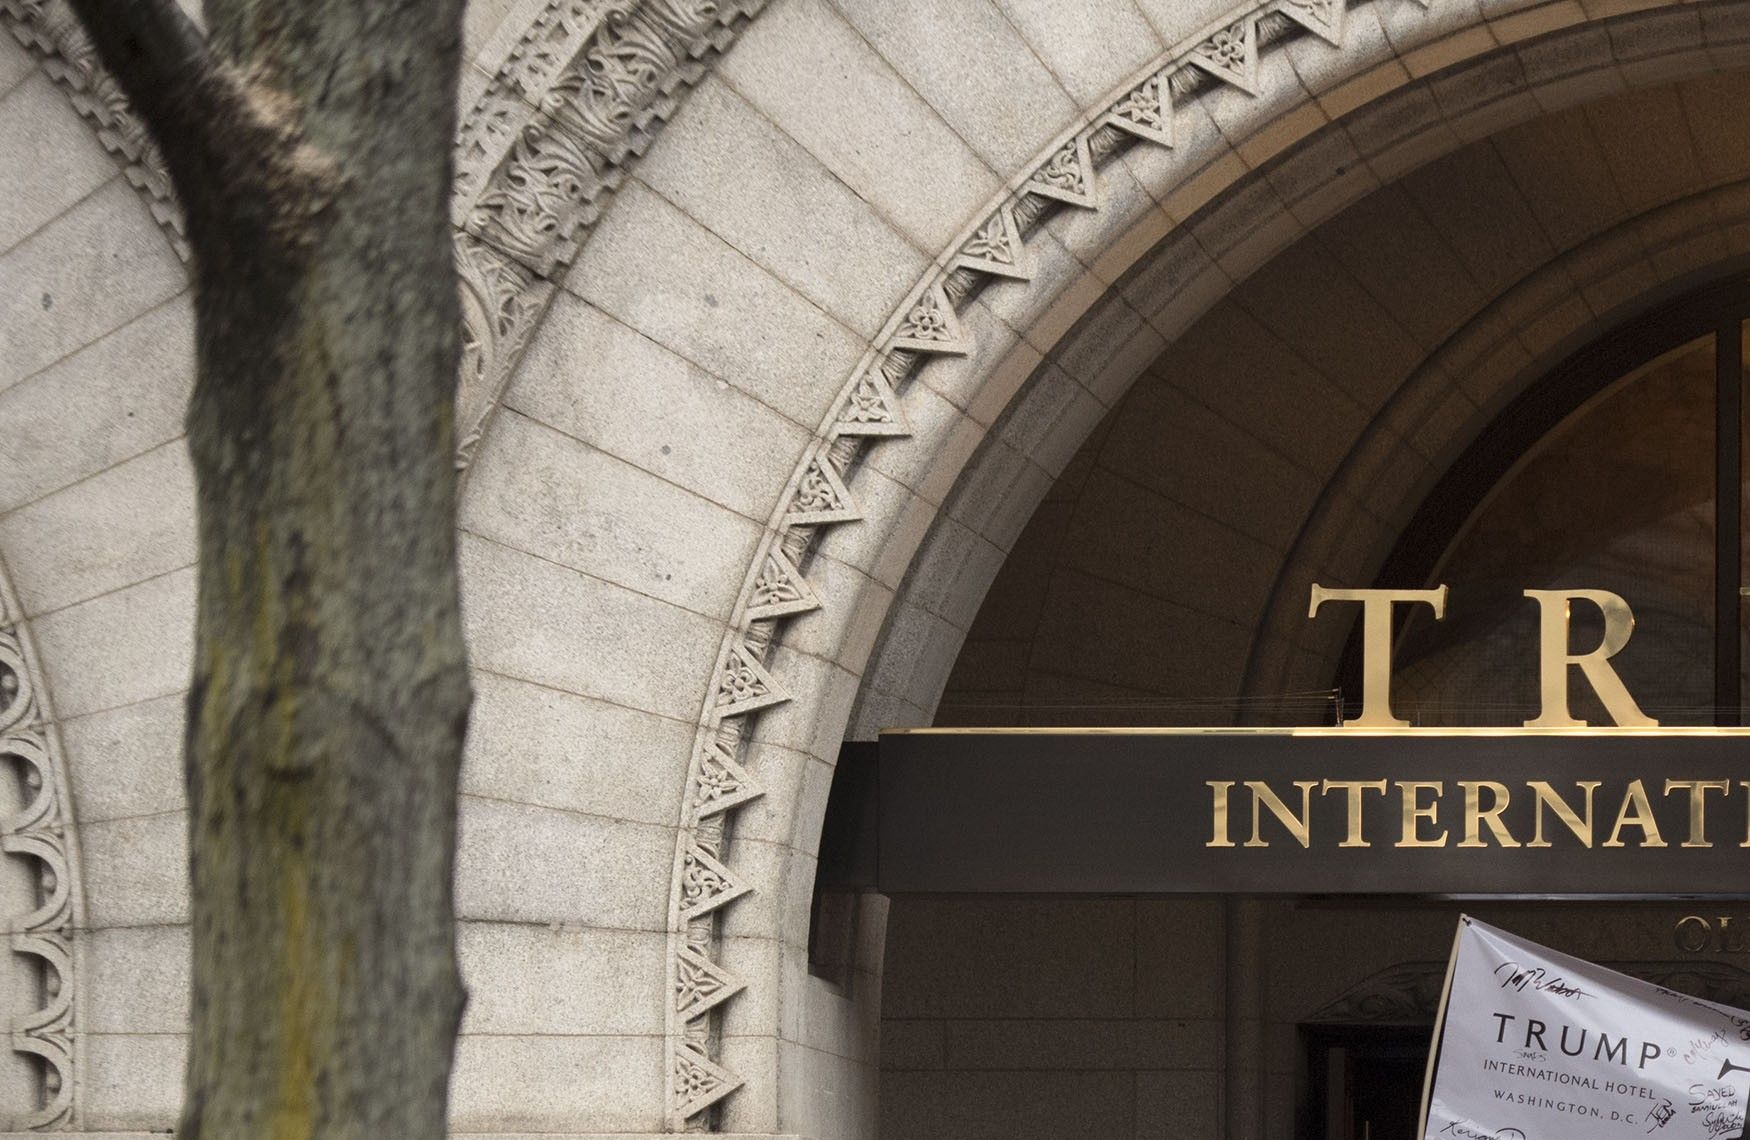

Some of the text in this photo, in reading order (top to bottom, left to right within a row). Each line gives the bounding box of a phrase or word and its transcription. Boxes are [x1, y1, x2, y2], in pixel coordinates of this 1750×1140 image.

[1484, 1058, 1657, 1101] INTERNATIONAL HOTEL
[1688, 1083, 1737, 1106] SAYED
[1610, 1110, 1638, 1125] D.C.
